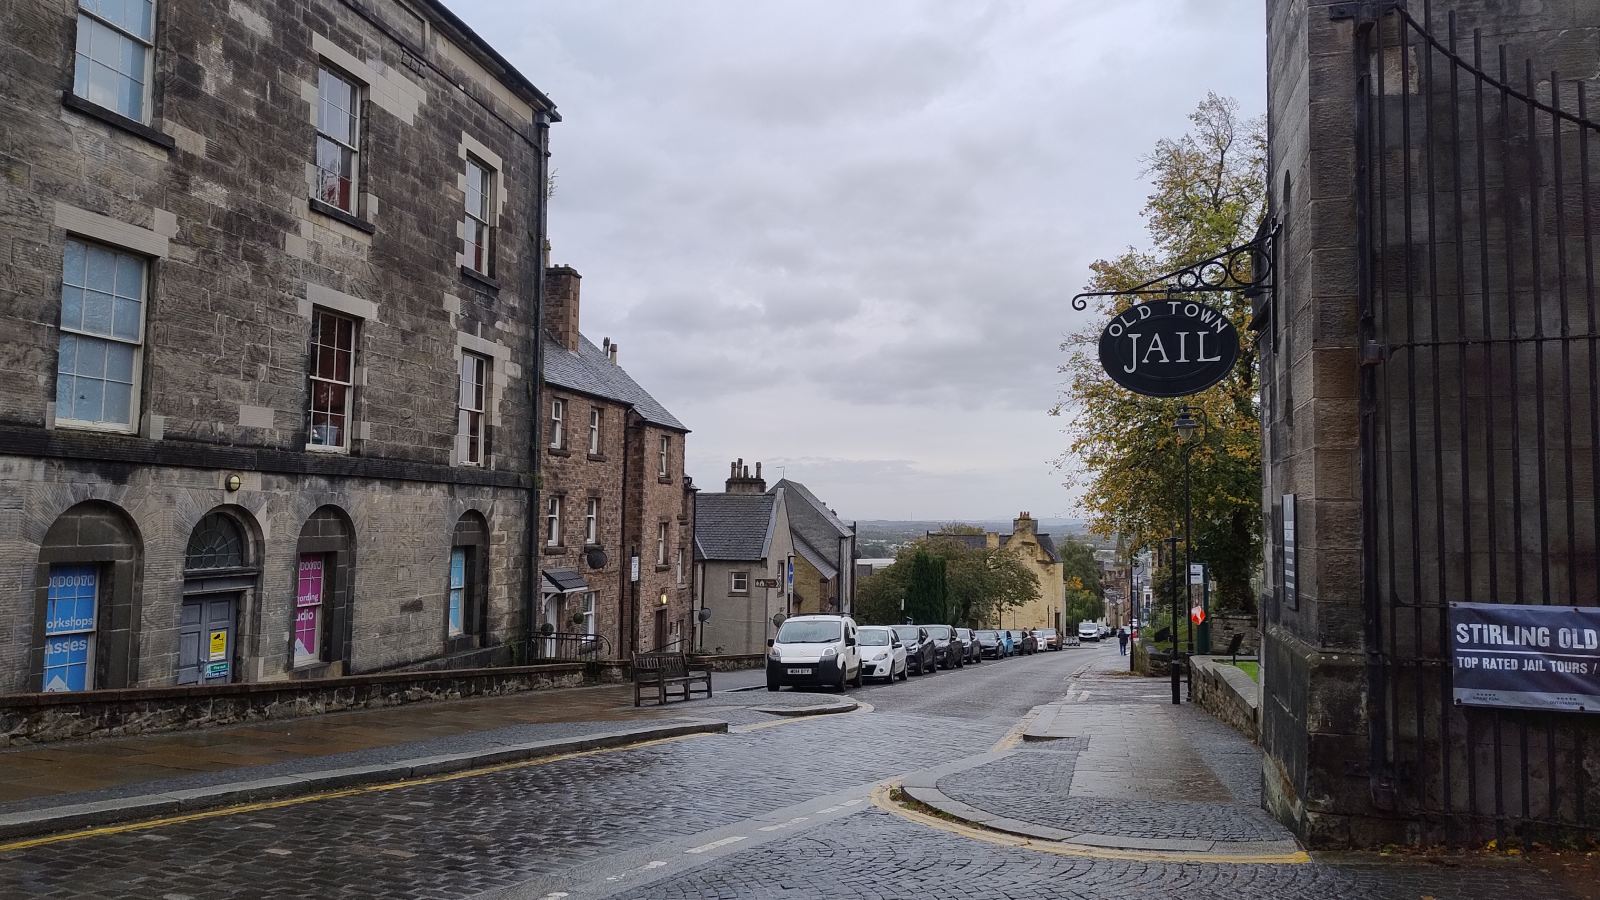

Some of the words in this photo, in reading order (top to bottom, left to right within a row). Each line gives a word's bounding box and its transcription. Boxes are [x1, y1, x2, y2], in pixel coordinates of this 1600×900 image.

[1109, 305, 1151, 337] OLD
[1167, 301, 1228, 334] TOWN
[1123, 331, 1221, 374] JAIL
[1456, 623, 1550, 647] STIRLING
[1558, 627, 1598, 650] OLD
[1456, 656, 1479, 669] TOP
[1482, 657, 1518, 670] RATED
[1522, 659, 1546, 672] JAIL
[1549, 660, 1588, 674] TOURS
